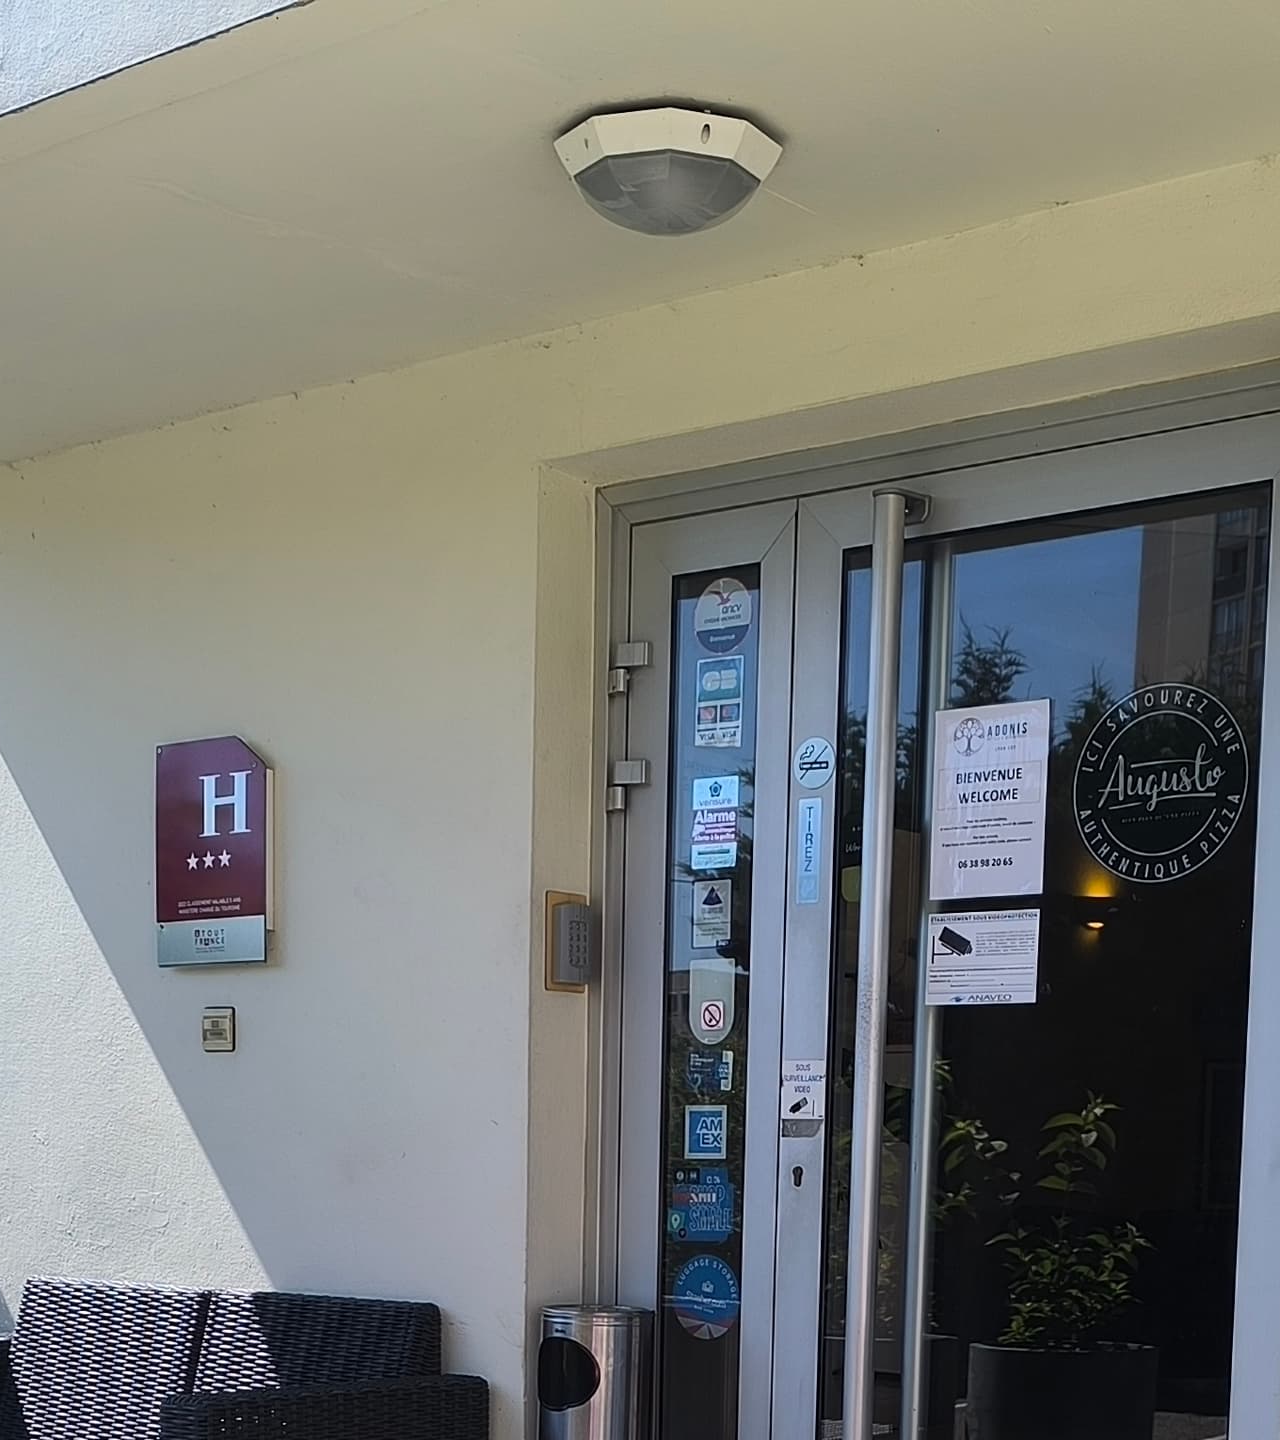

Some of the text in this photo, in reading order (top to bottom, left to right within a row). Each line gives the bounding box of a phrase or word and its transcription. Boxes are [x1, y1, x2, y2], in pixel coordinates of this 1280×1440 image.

[987, 722, 1028, 737] ADONIS
[1081, 689, 1240, 772] ICI SAVOUREZ UNE
[956, 767, 1023, 785] BIENVENUE
[958, 788, 1018, 804] WELCOME
[1097, 743, 1226, 812] Augusto
[198, 770, 252, 837] H
[804, 806, 814, 872] TIREZ
[958, 860, 968, 869] 06
[969, 859, 979, 868] 38
[991, 857, 1002, 867] 20
[1003, 857, 1013, 866] 65
[1079, 794, 1241, 879] AUTHENTIQUE PIZZA
[677, 1258, 738, 1299] LUGGAGE STORAGE
